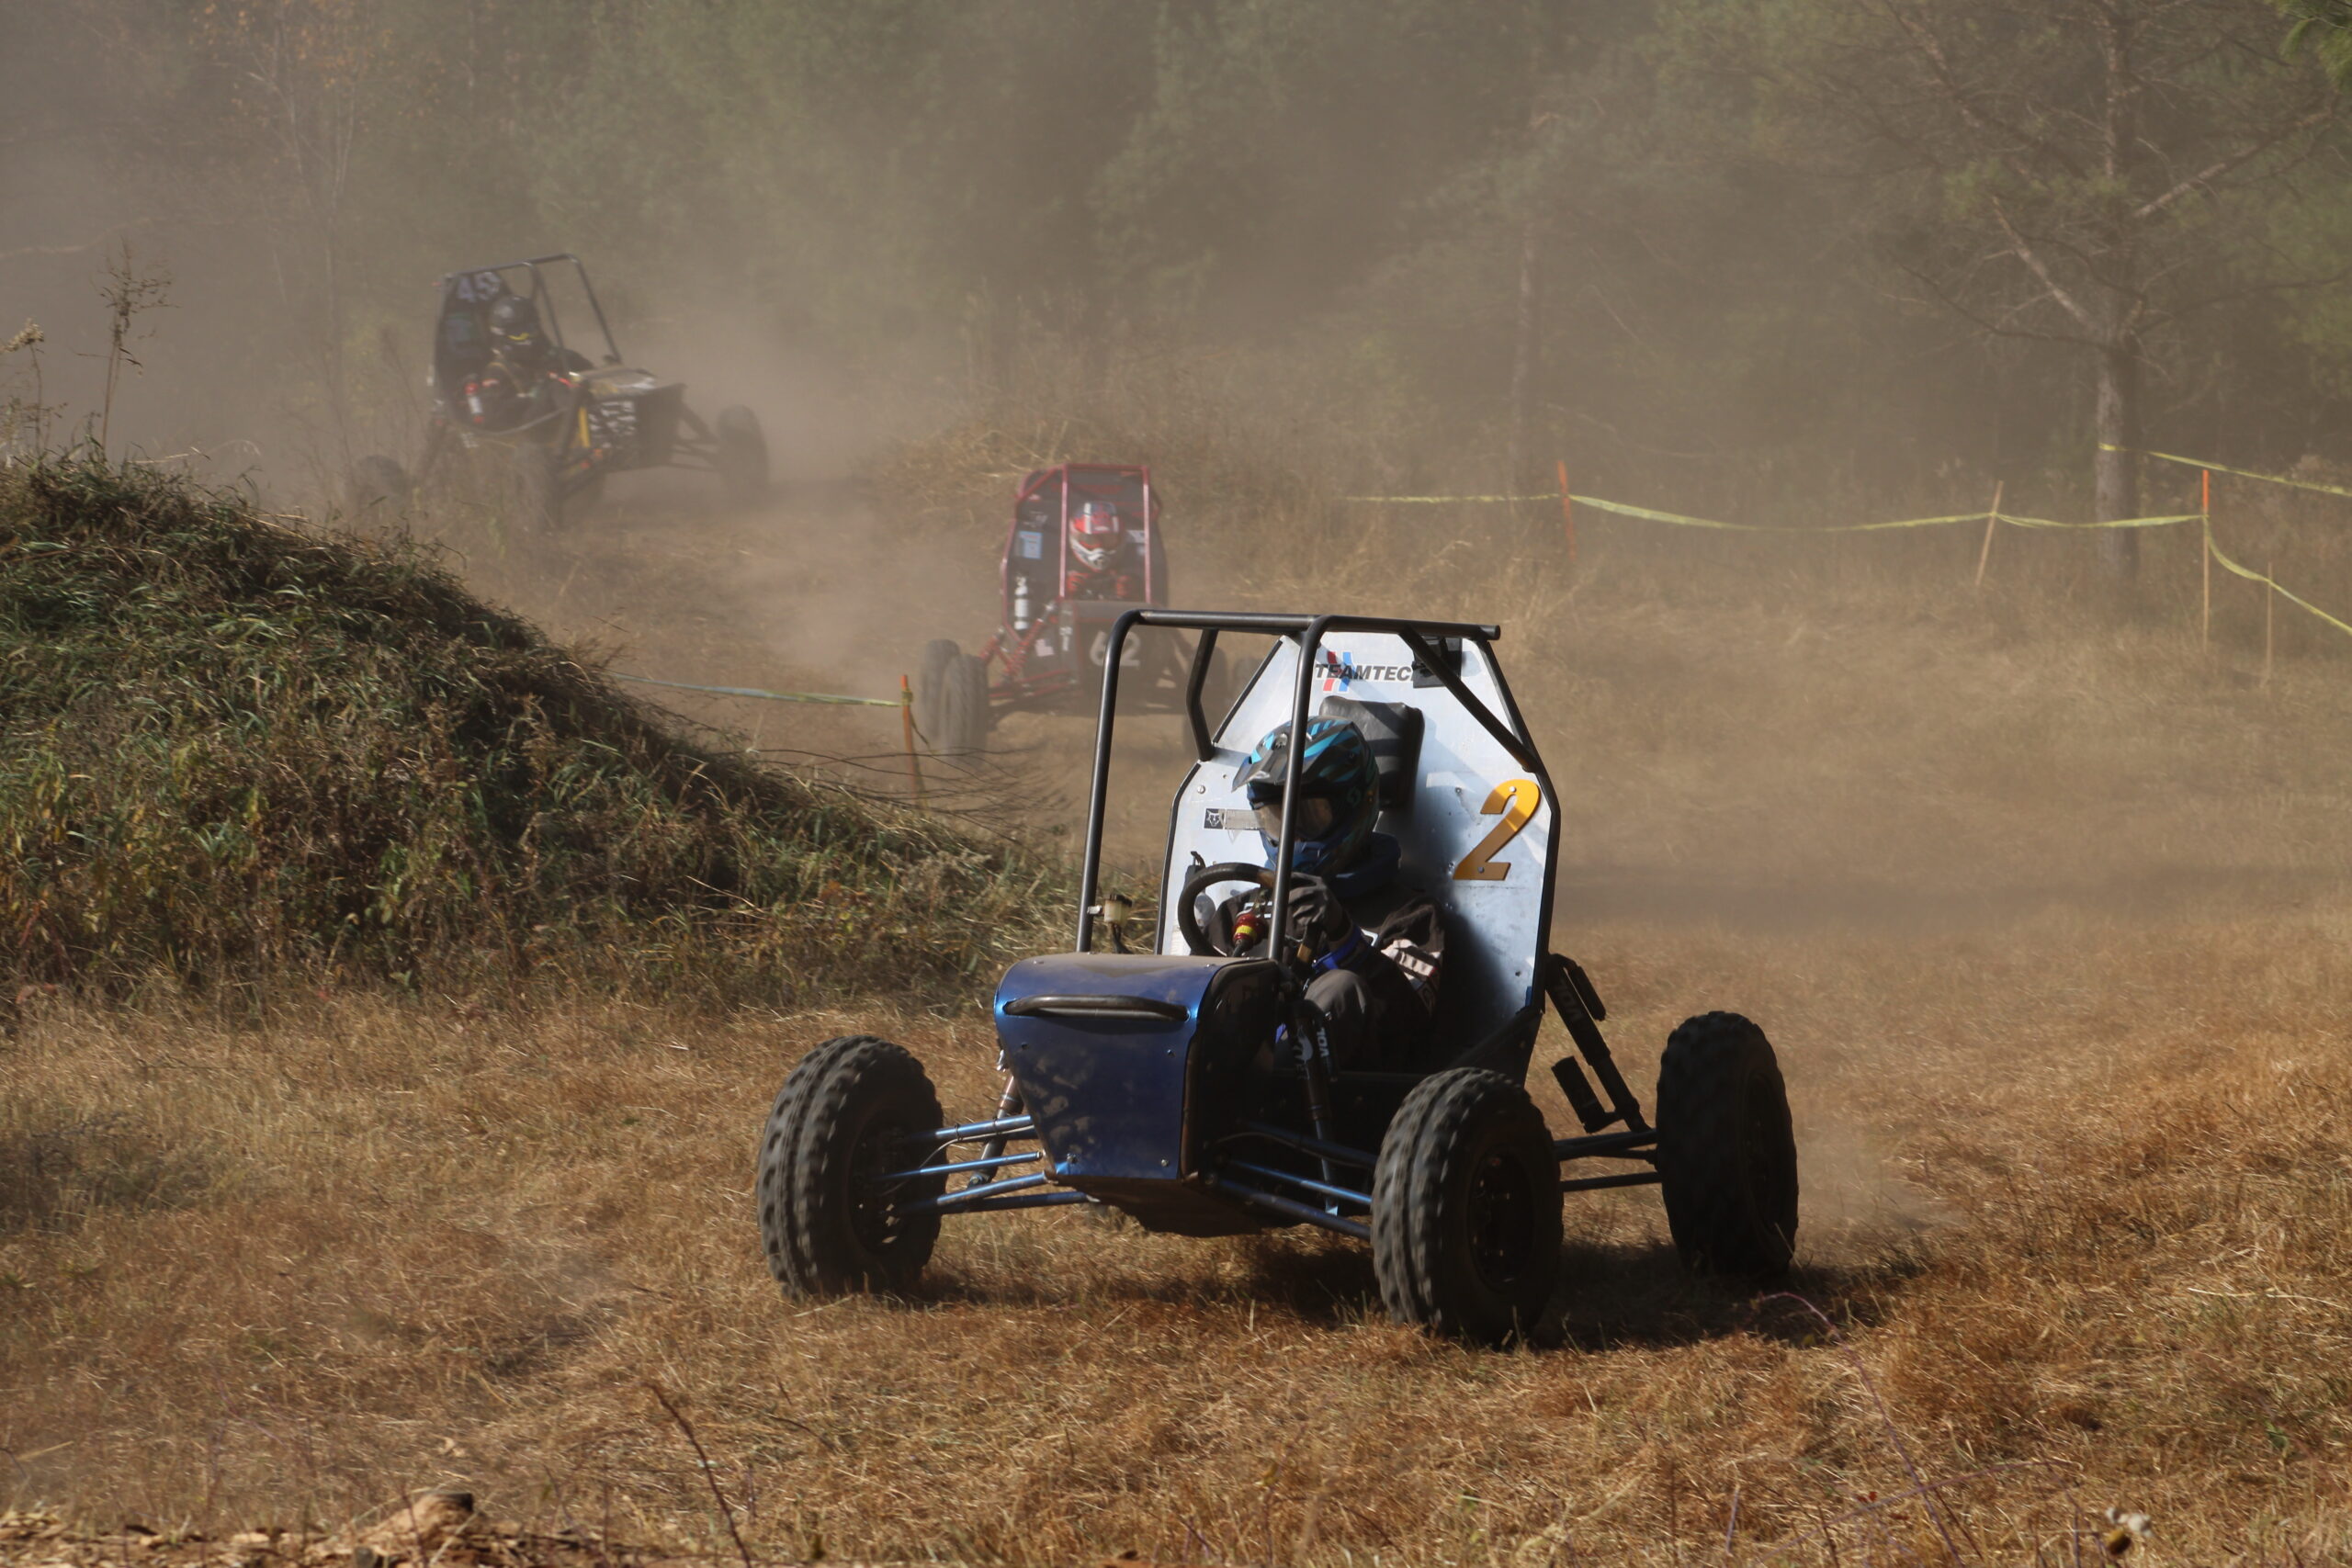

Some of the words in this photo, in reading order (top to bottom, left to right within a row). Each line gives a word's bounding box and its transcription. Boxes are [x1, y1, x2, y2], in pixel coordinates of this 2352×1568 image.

[1090, 631, 1140, 666] 62
[1315, 663, 1415, 681] TEAMTEC
[1453, 779, 1541, 881] 2
